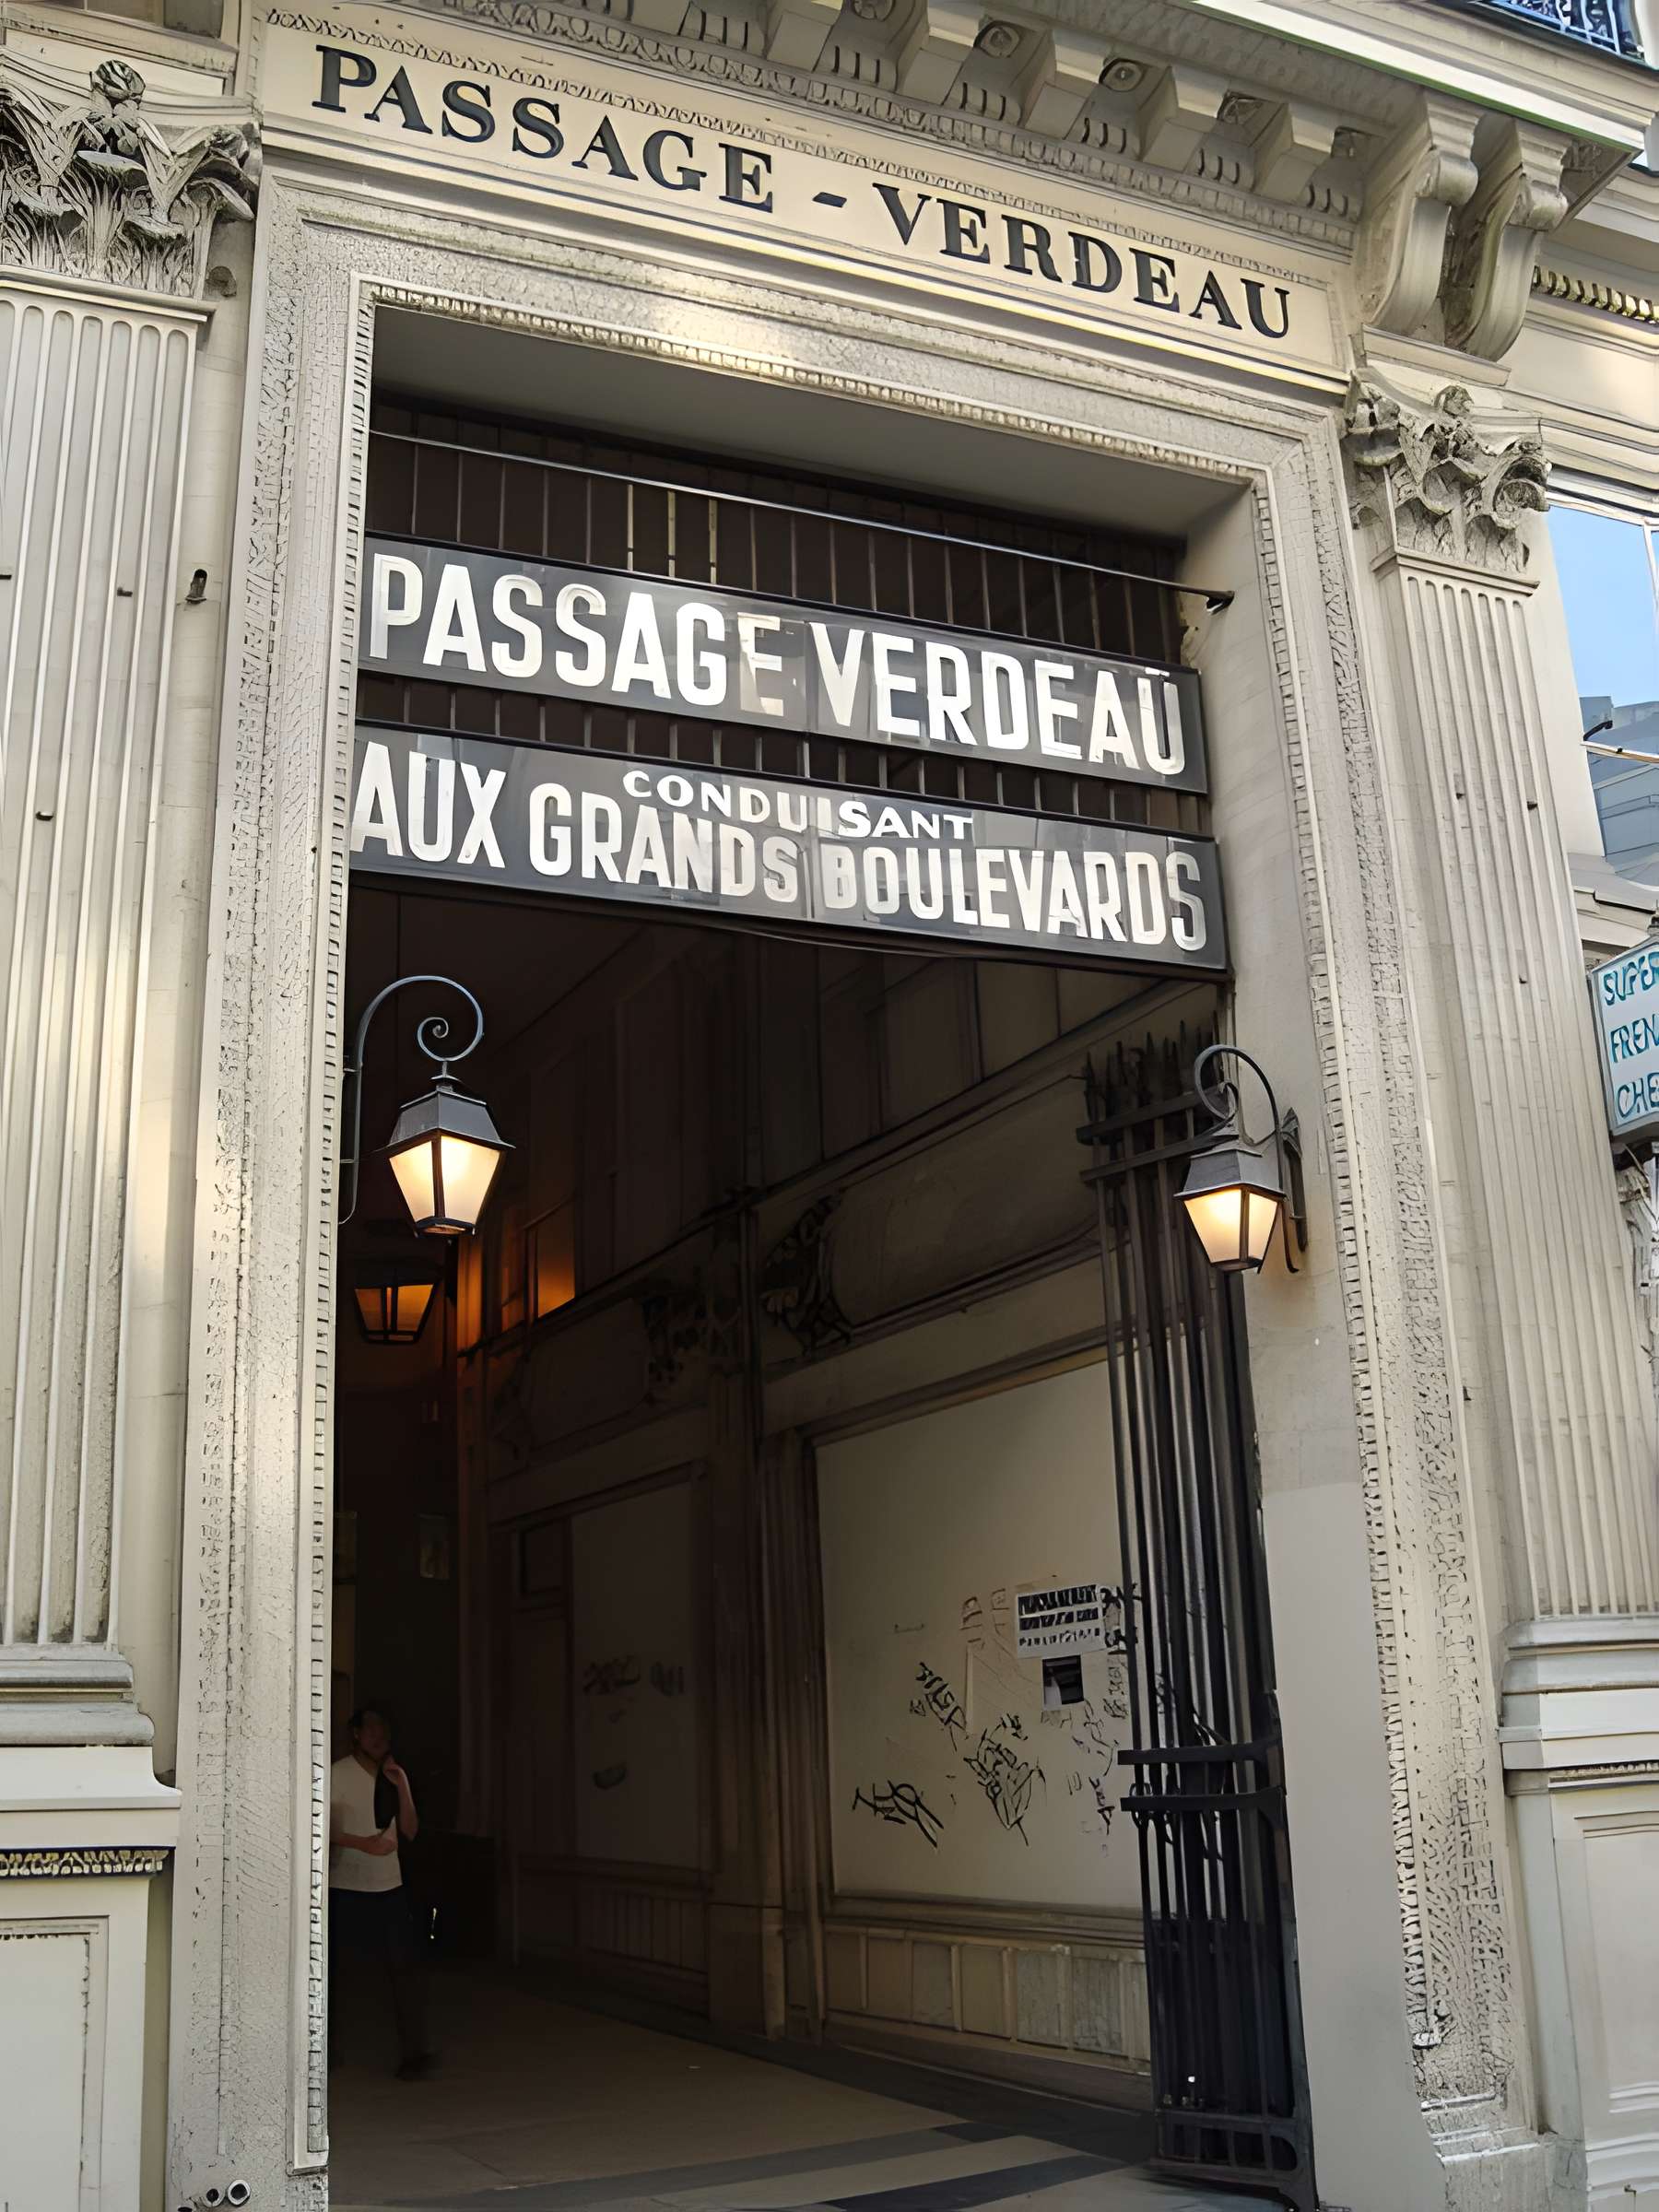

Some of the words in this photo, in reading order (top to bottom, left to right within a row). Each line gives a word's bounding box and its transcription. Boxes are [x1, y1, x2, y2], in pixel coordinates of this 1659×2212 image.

[312, 44, 774, 214] PASSAGE
[872, 182, 1290, 339] VERDEAU
[369, 552, 785, 717] PASSAGE
[808, 621, 1186, 775] VERDEAU
[349, 740, 507, 868] AUX
[528, 782, 799, 903] GRANDS
[819, 842, 1207, 951] BOULEVARDS
[622, 770, 973, 839] CONDUISANT
